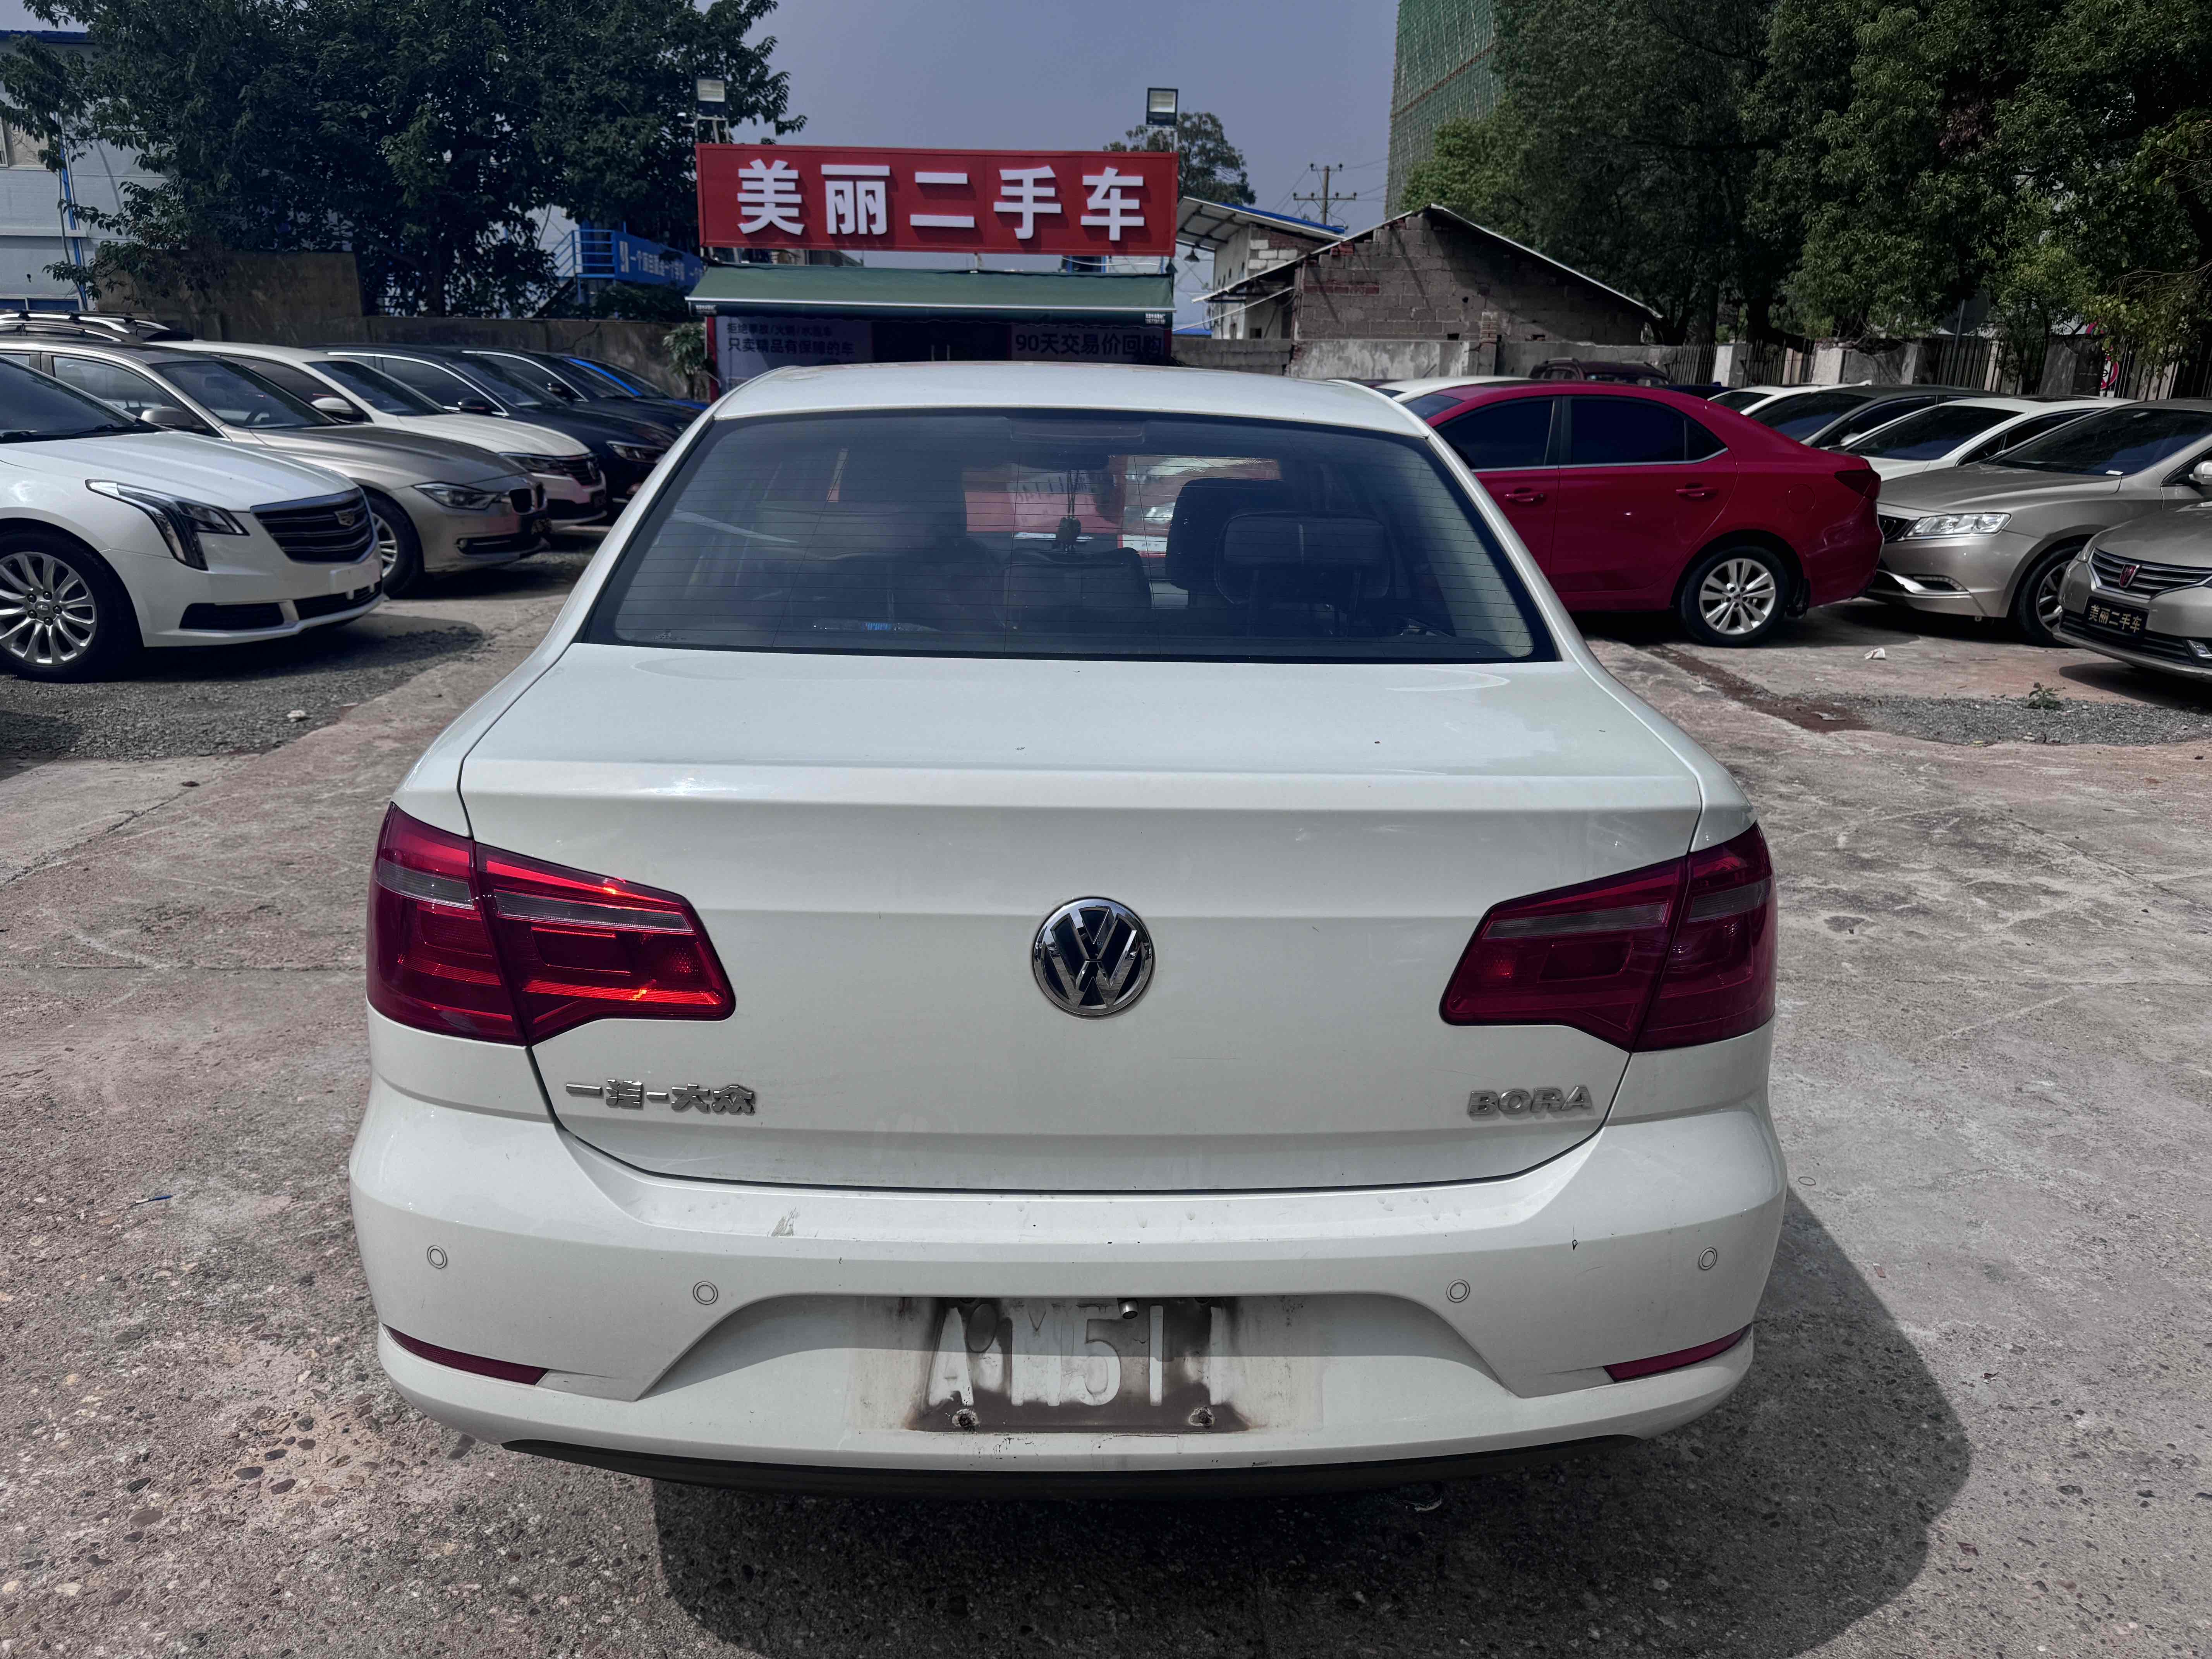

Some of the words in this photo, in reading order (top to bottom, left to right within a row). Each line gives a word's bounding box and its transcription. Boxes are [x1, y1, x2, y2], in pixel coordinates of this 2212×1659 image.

[737, 159, 1145, 241] 美丽二手车
[2088, 604, 2142, 633] 美丽二手车
[1468, 1085, 1592, 1116] BORA
